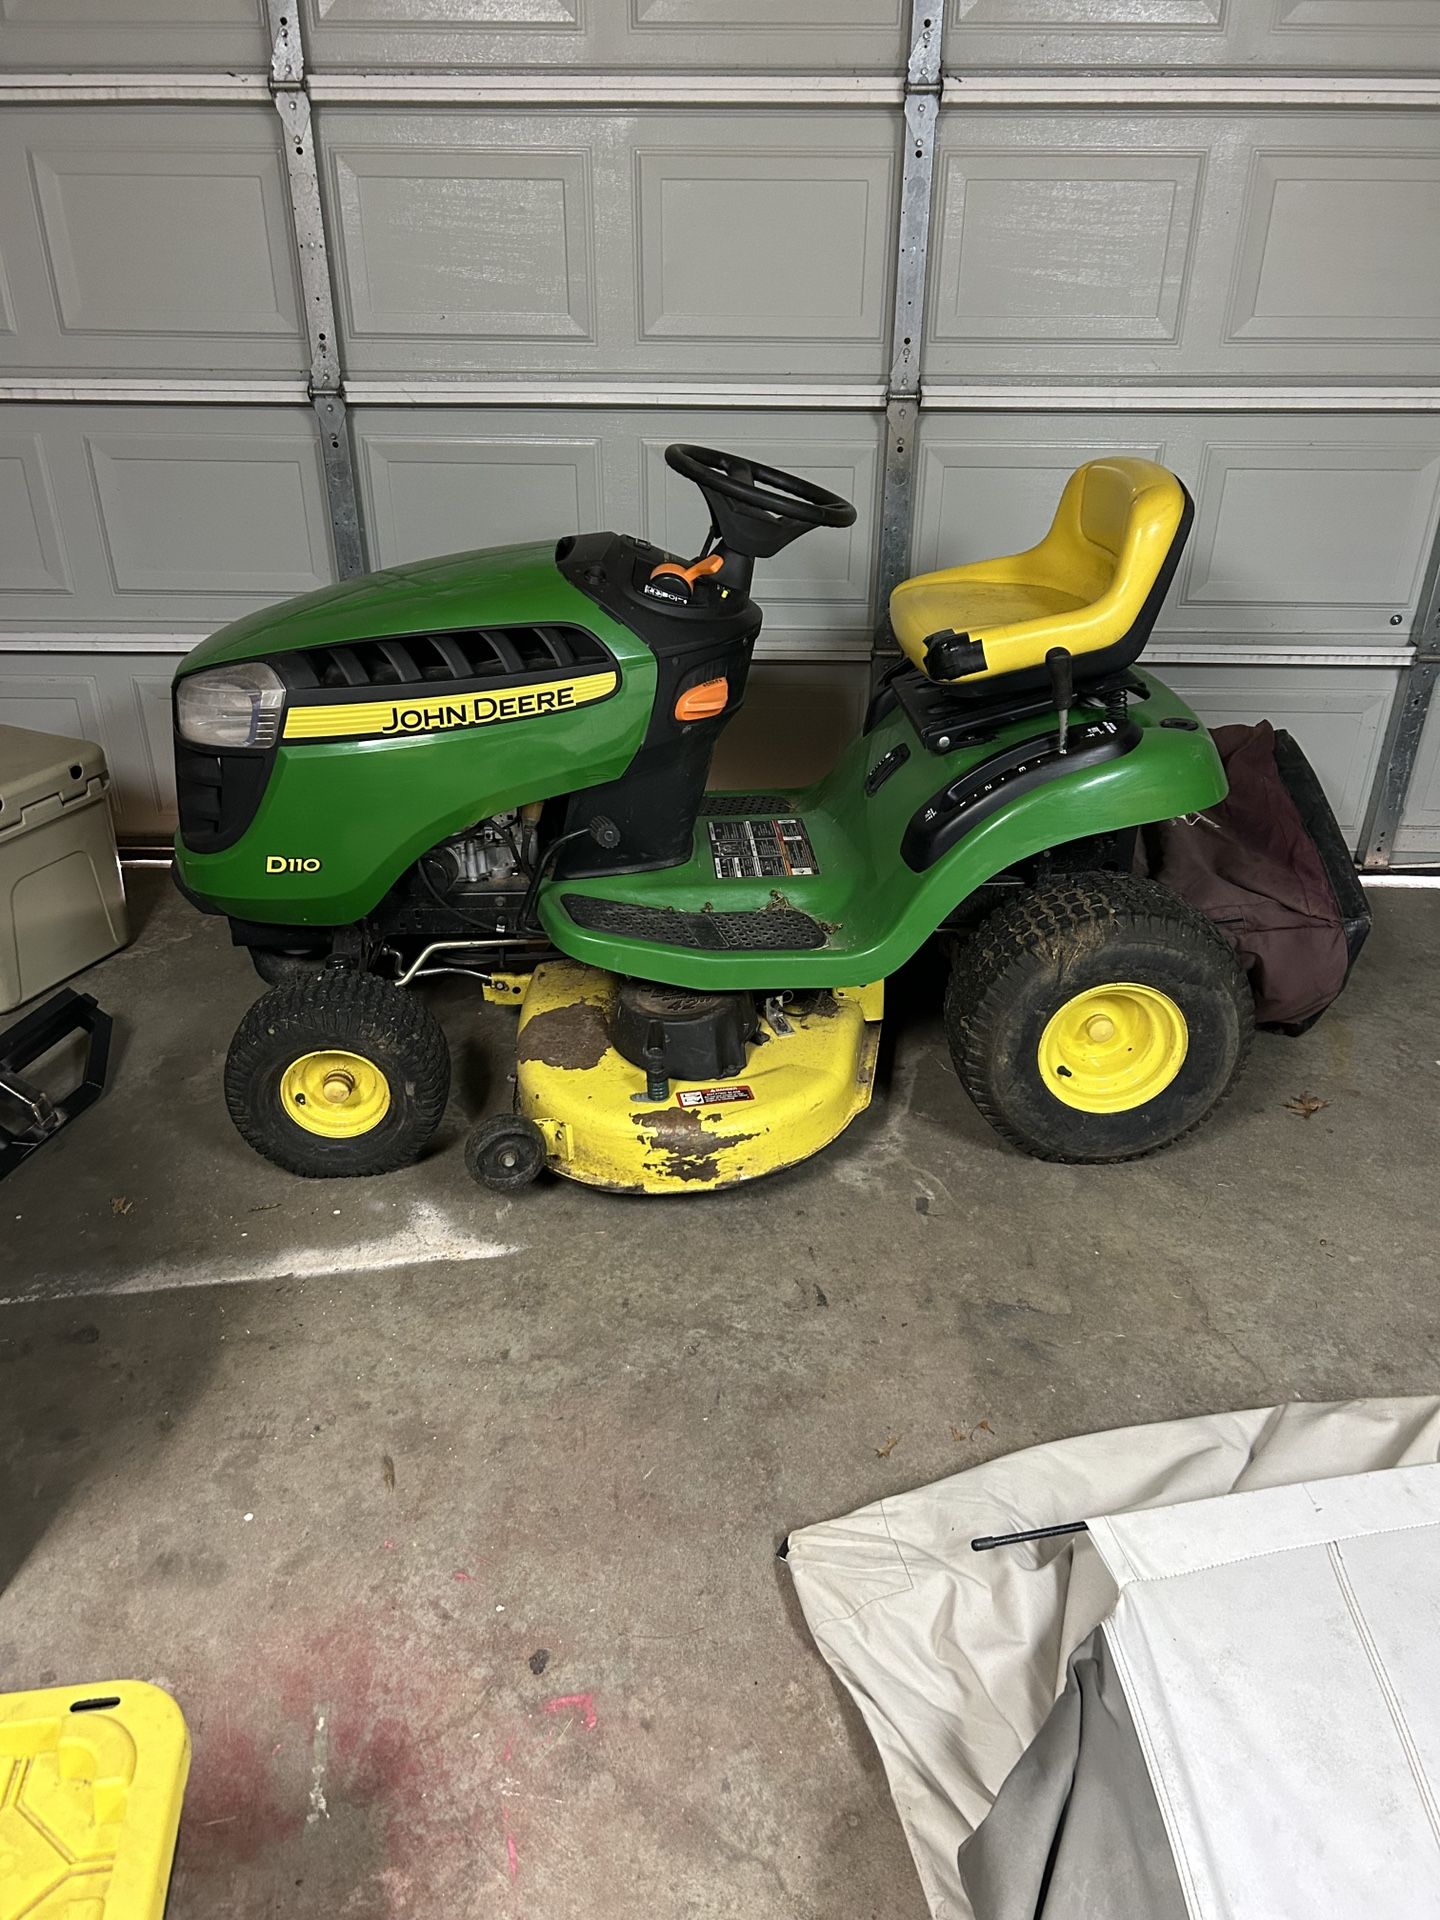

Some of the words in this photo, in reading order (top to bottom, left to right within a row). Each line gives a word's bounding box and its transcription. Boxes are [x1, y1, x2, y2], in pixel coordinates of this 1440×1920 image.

[382, 704, 467, 731] JOHN
[474, 686, 575, 721] DEERE
[984, 783, 993, 791] 2
[1018, 765, 1027, 773] 3
[266, 856, 320, 873] D110
